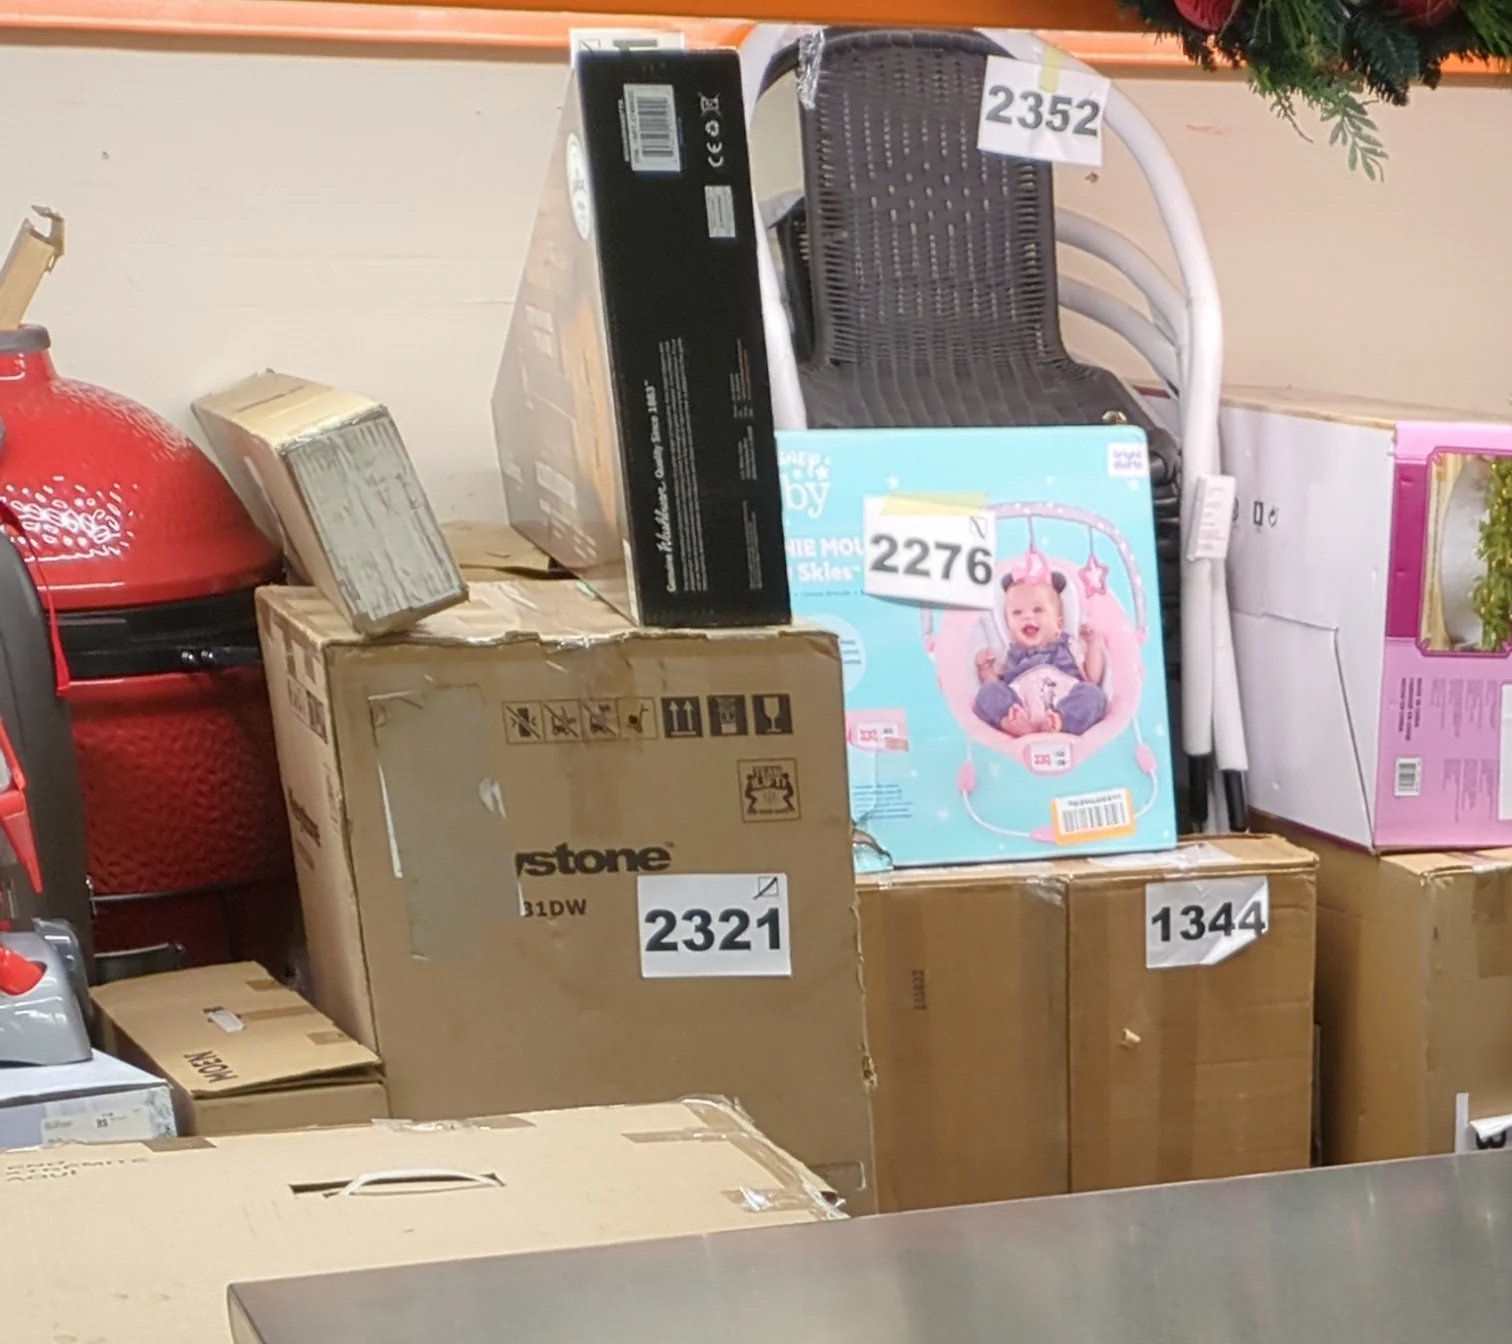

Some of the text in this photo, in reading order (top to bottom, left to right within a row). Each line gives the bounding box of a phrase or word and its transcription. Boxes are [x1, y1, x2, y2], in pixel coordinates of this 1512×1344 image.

[985, 84, 1100, 137] 2352
[782, 474, 831, 518] by
[870, 533, 993, 586] 2276
[644, 907, 781, 952] 2321
[1151, 901, 1266, 942] 1344
